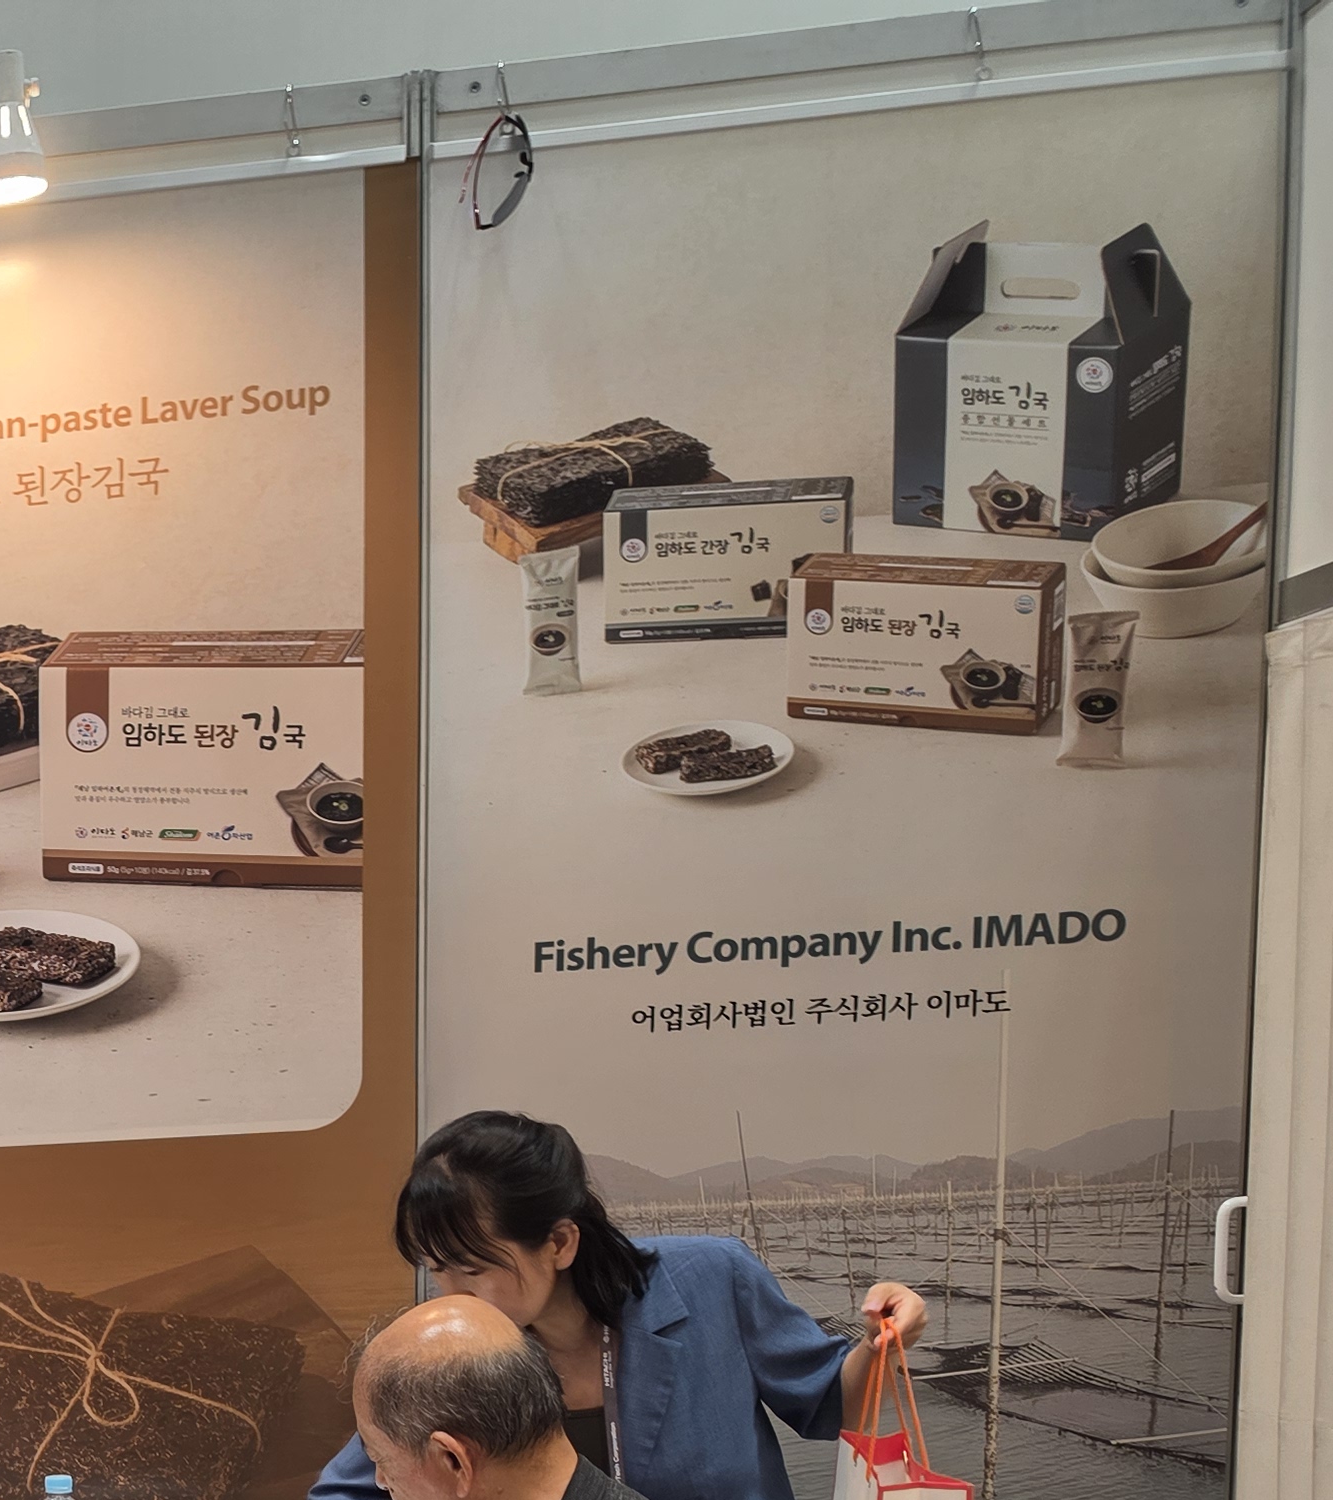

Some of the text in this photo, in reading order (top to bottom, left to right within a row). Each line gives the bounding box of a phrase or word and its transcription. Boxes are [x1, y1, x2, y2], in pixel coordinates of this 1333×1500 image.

[141, 394, 234, 425] Laver
[241, 381, 330, 417] Soup
[961, 388, 1006, 405] 임하도
[12, 456, 169, 508] 된장김국
[655, 542, 697, 557] 임하도
[701, 540, 729, 555] 간장
[841, 617, 884, 633] 임하도
[888, 620, 917, 636] 된장
[121, 706, 190, 718] 바다김 그대로
[123, 723, 187, 747] 임하도
[194, 724, 239, 748] 된장
[533, 908, 1126, 975] Fishery Company Inc. IMADO
[632, 988, 1011, 1033] 어업회사법인 주식회사 이마도
